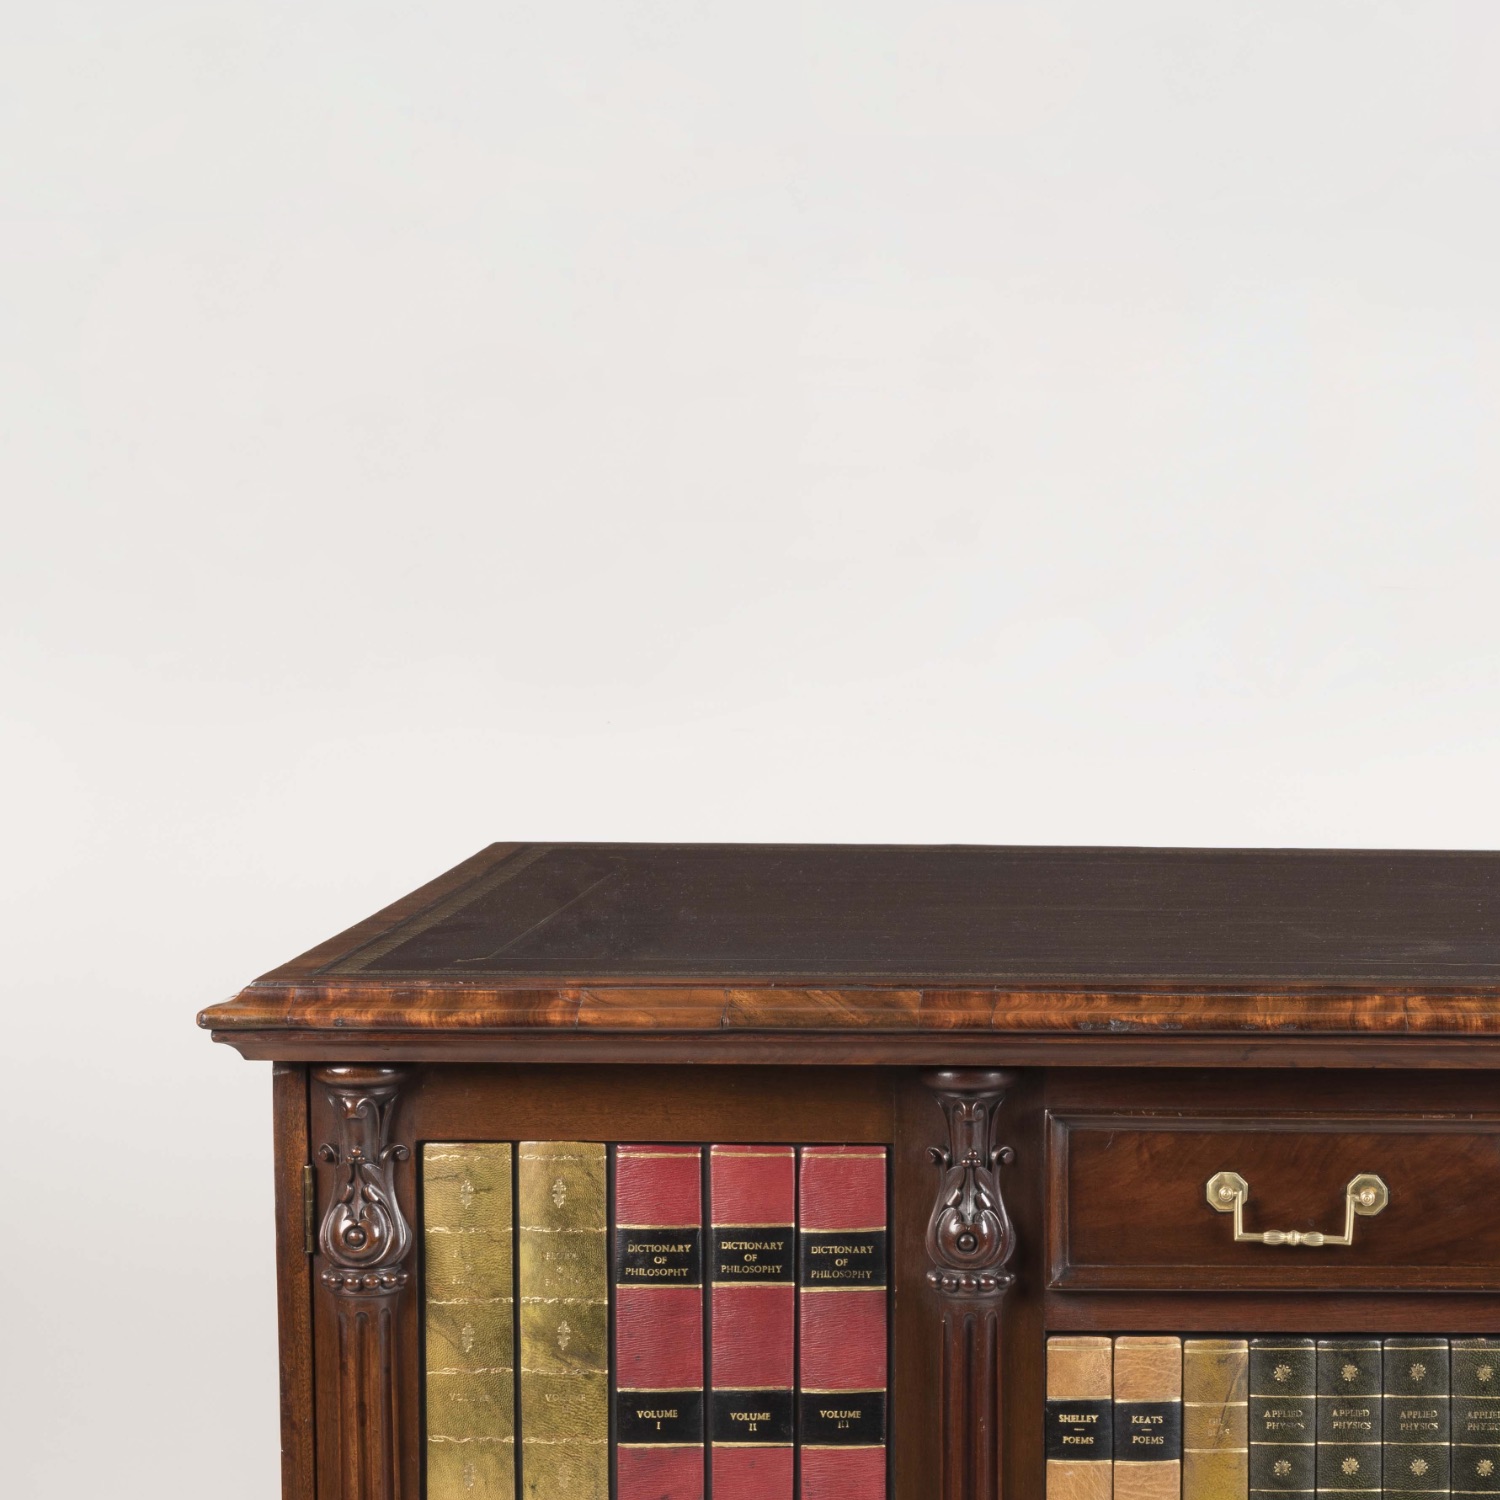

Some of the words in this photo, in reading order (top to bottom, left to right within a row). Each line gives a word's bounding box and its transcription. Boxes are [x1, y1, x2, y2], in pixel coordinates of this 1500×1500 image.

[628, 1244, 691, 1253] DICTIONARY
[721, 1241, 784, 1250] DICTIONARY
[811, 1245, 874, 1254] DICTIONARY
[653, 1256, 667, 1264] OF
[744, 1254, 757, 1262] OF
[835, 1258, 848, 1266] OF
[625, 1268, 688, 1276] PHILOSOPHY
[721, 1265, 783, 1273] PHILOSOPHY
[811, 1270, 872, 1279] PHILOSOPHY
[637, 1409, 678, 1418] VOLUME
[730, 1412, 771, 1421] VOLUME
[820, 1410, 861, 1419] VOLUME
[1264, 1409, 1303, 1418] APPLIED
[1332, 1409, 1370, 1418] APPLIED
[1400, 1410, 1438, 1419] APPLIED
[1059, 1414, 1098, 1423] SHELLEY
[1131, 1416, 1163, 1424] KEATS
[656, 1421, 661, 1430] I
[748, 1423, 757, 1432] II
[1266, 1421, 1305, 1430] PHYSICS
[1333, 1421, 1371, 1430] PHYSICS
[1400, 1422, 1439, 1431] PHYSICS
[1062, 1436, 1094, 1444] POEMS
[1132, 1436, 1164, 1444] POEMS
